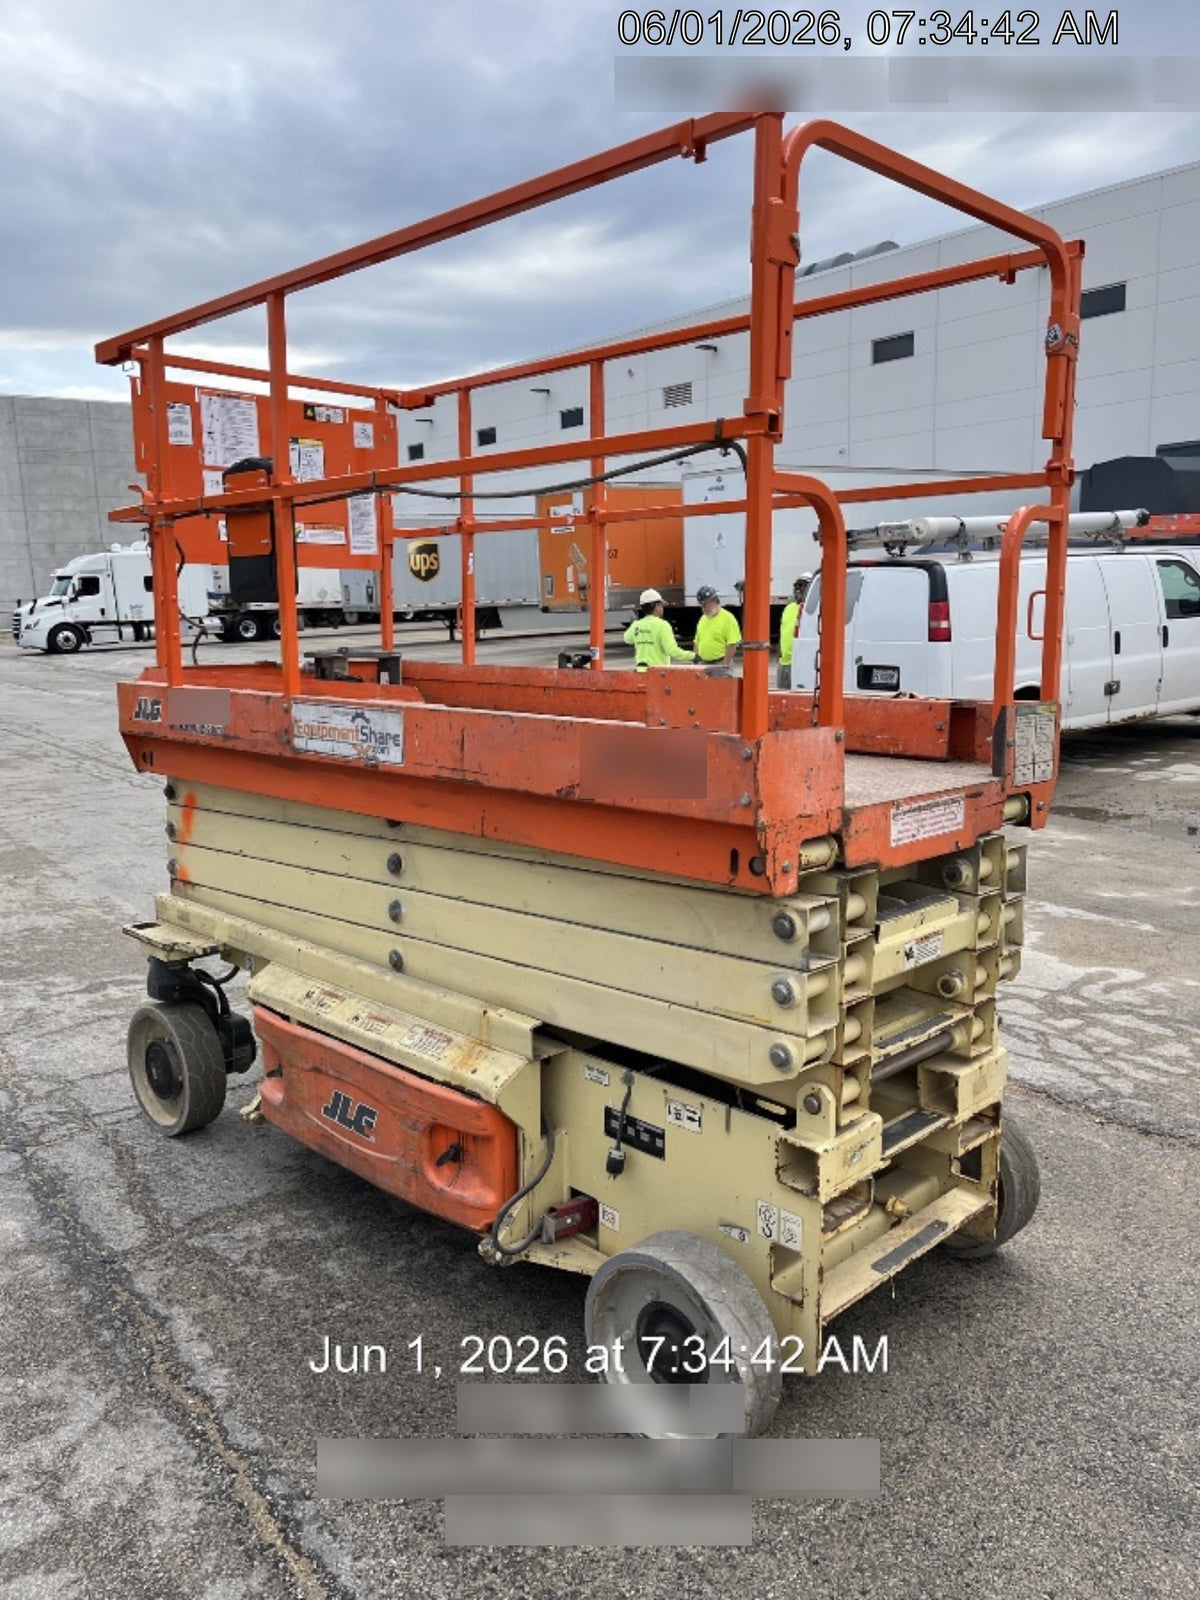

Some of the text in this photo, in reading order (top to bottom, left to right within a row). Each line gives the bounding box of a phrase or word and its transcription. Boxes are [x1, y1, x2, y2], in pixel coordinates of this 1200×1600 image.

[410, 553, 438, 577] ups
[133, 697, 162, 722] JLG
[295, 721, 401, 748] EquipmentShare
[321, 1090, 378, 1141] JLG
